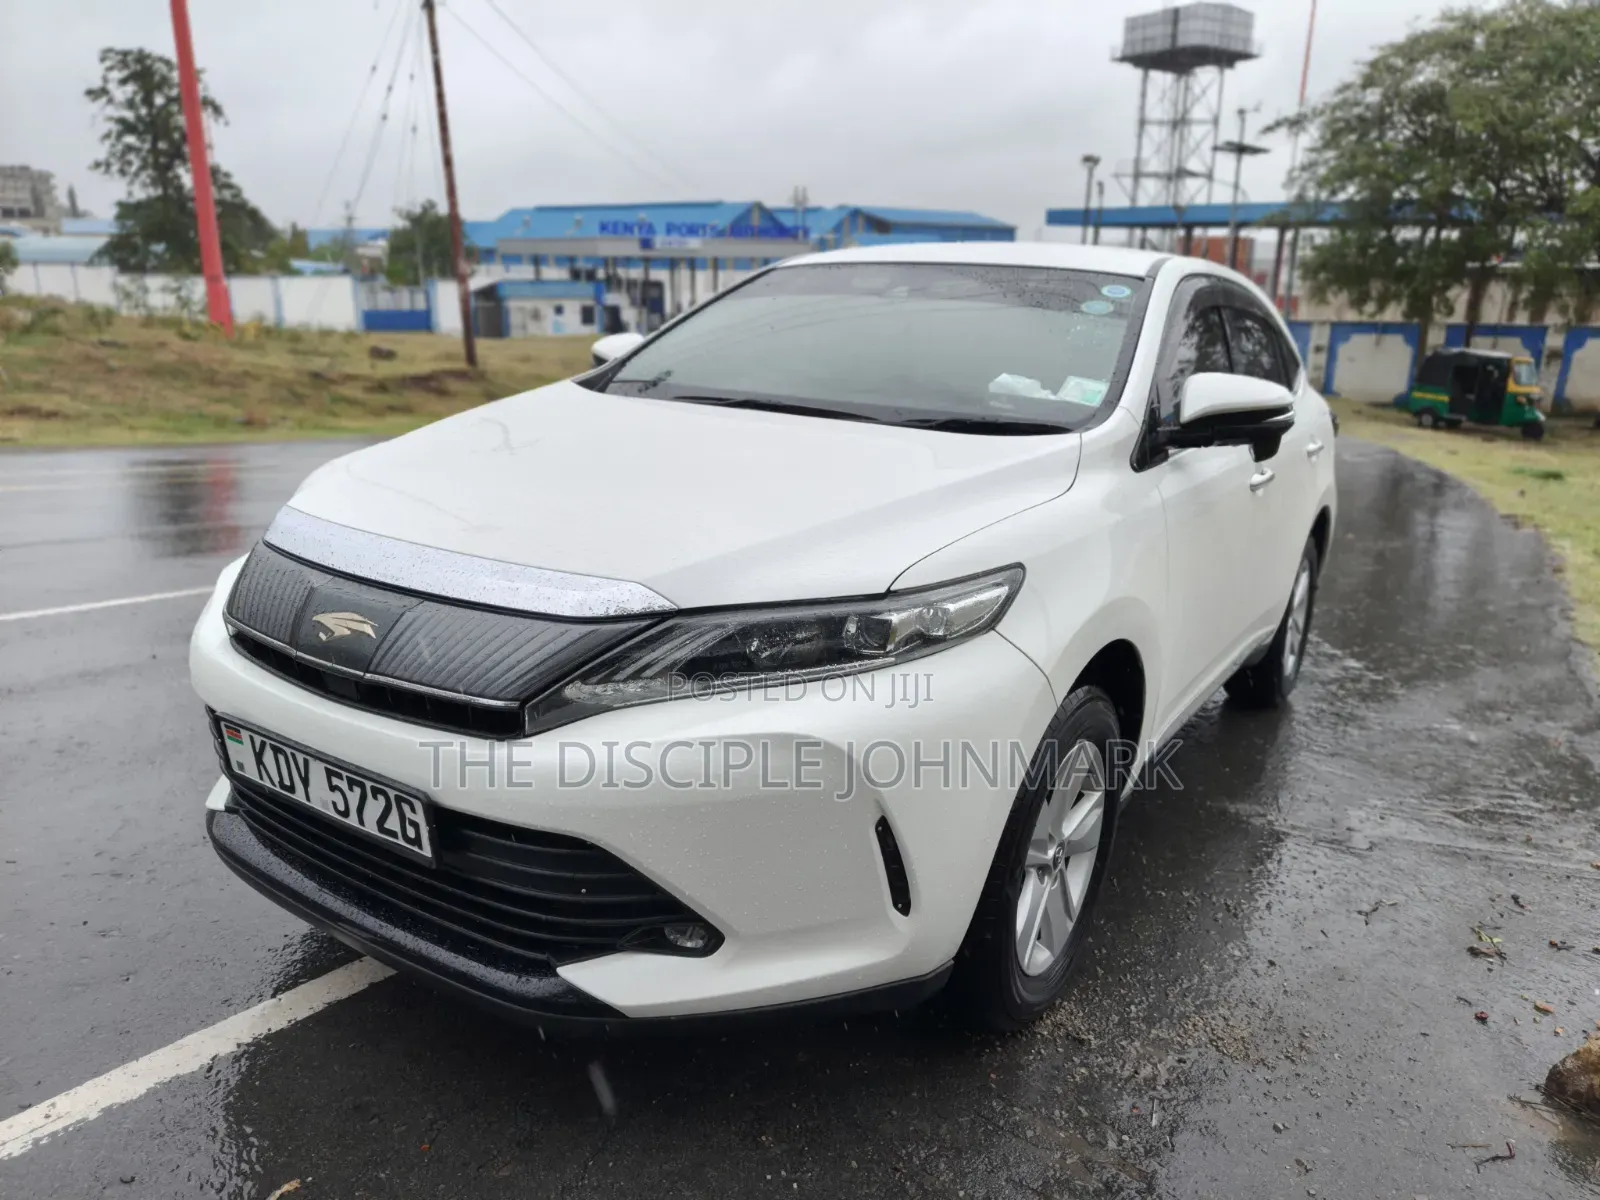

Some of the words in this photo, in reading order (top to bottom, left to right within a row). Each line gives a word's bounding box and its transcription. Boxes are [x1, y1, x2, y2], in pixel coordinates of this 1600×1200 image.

[598, 220, 656, 237] KENYA
[248, 733, 311, 802] KDY
[323, 765, 424, 851] 572G
